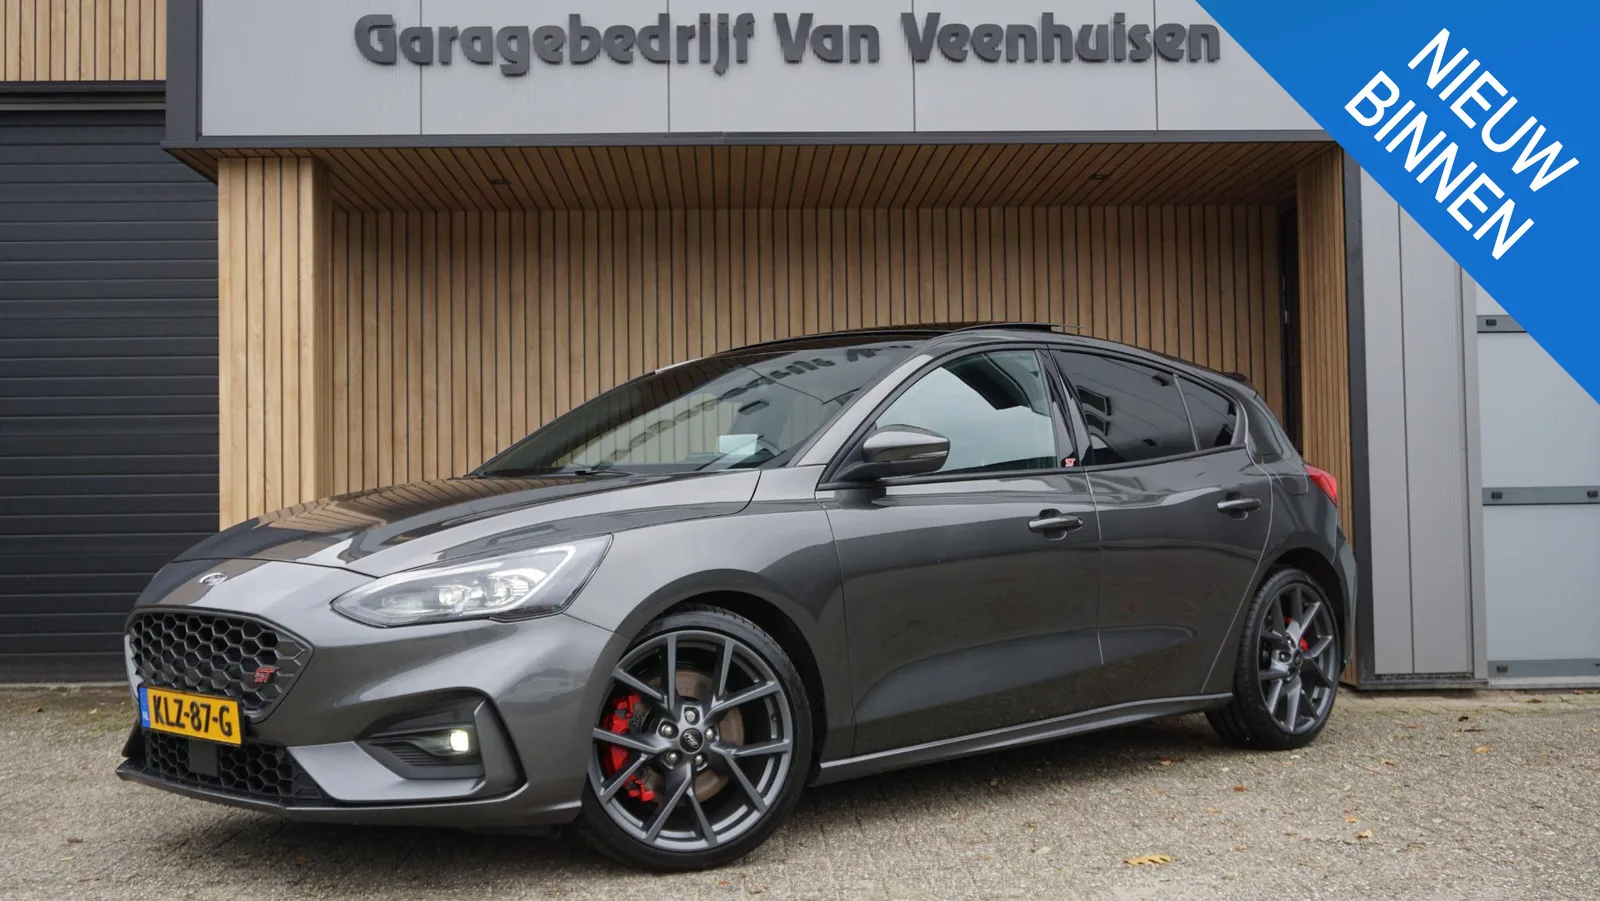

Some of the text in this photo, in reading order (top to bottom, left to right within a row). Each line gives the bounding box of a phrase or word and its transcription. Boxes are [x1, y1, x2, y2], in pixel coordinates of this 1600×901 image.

[354, 12, 1221, 76] Garagebedrijf Van Veenhuisen
[152, 695, 233, 737] KLZ-87-G
